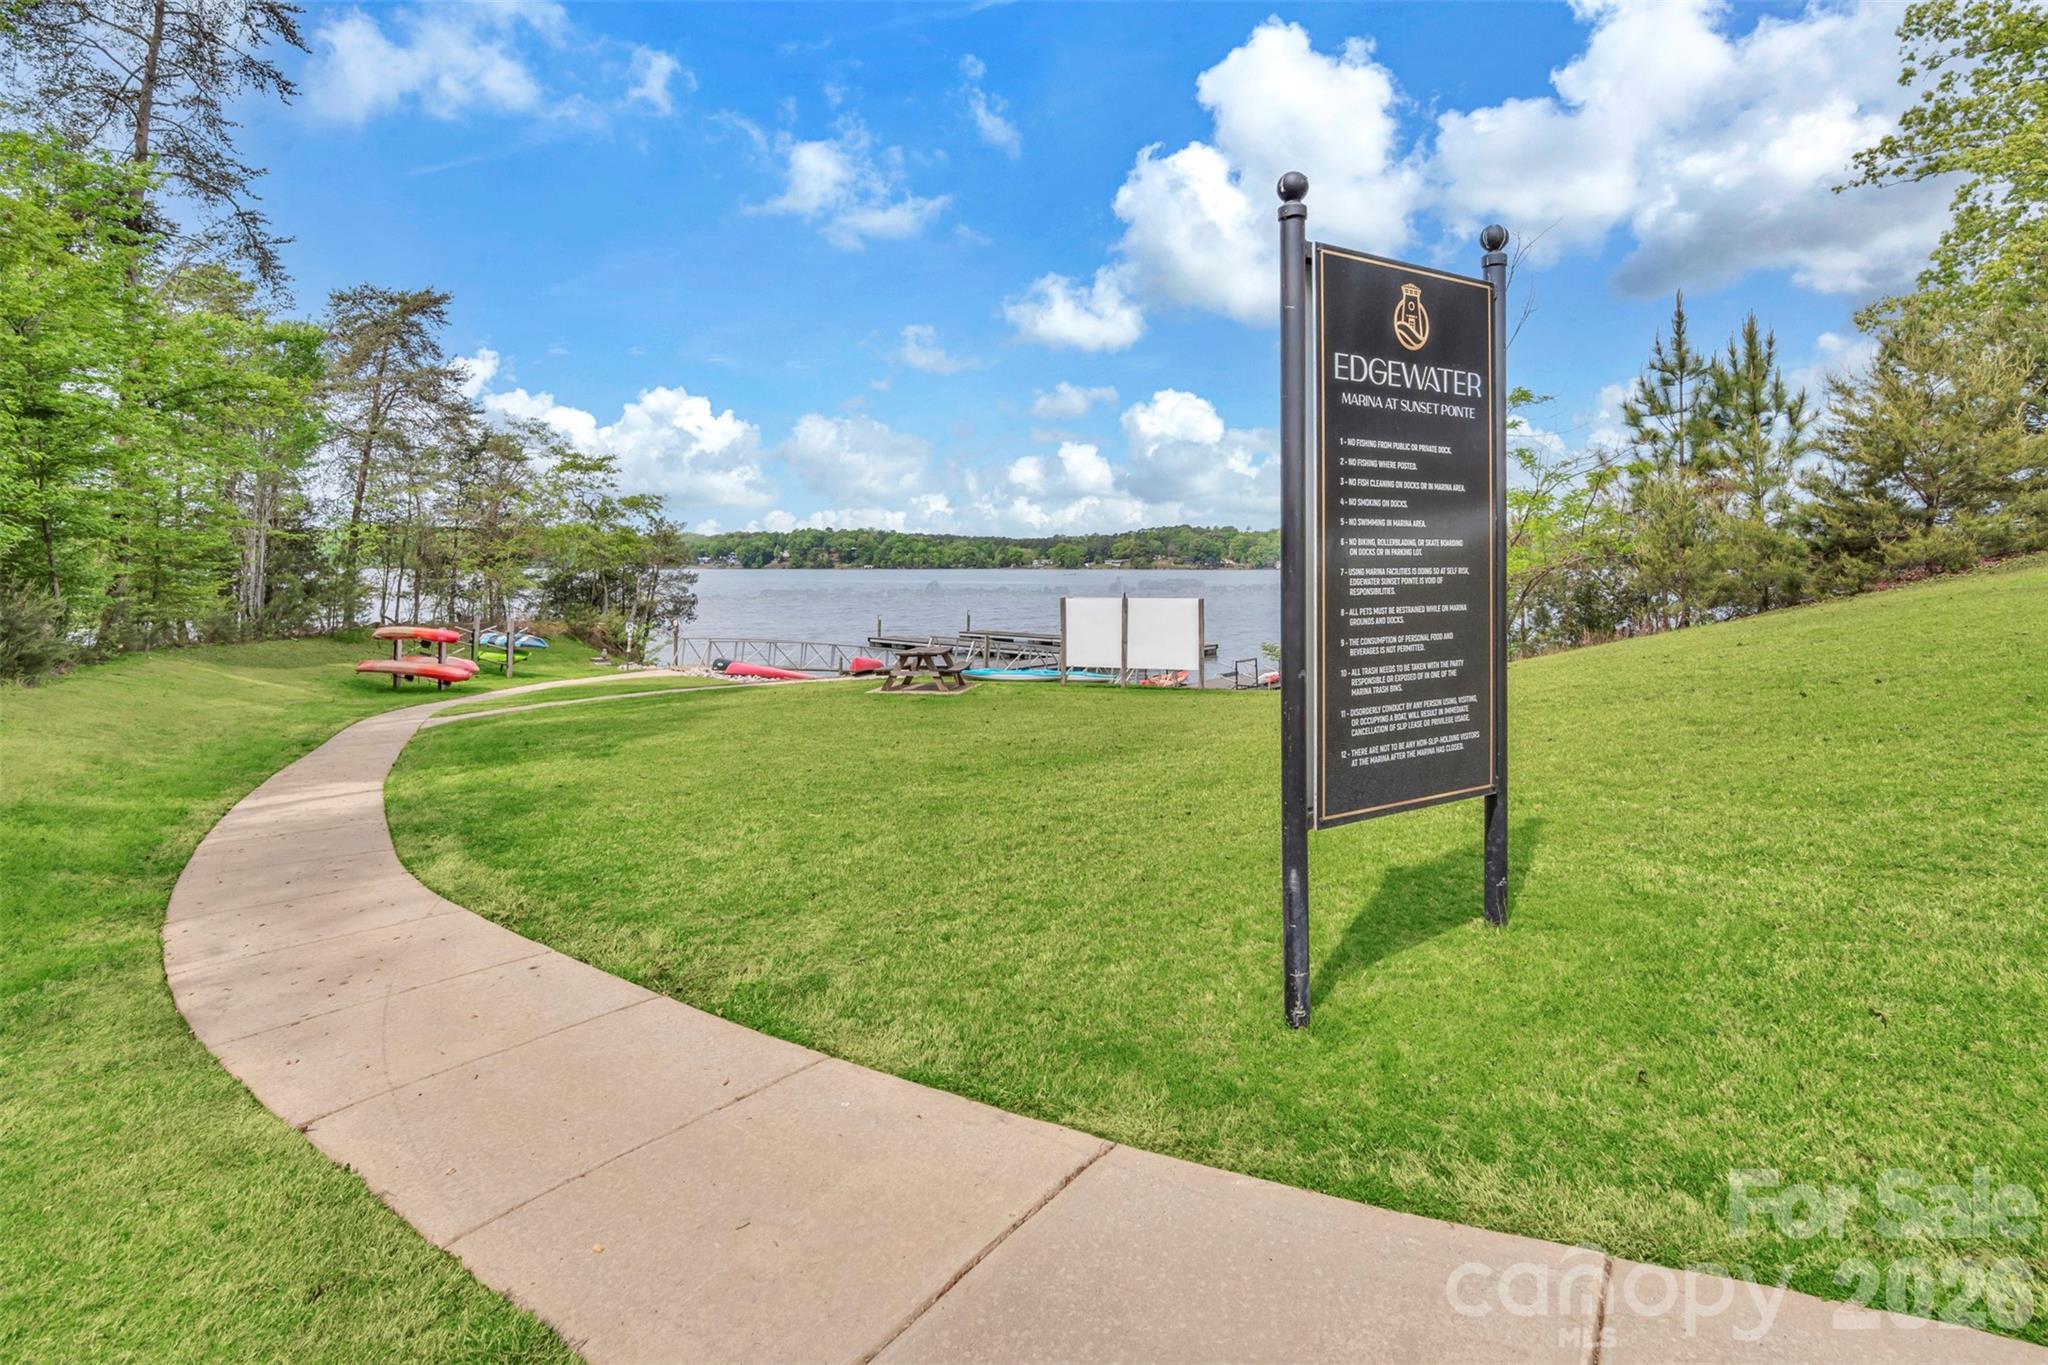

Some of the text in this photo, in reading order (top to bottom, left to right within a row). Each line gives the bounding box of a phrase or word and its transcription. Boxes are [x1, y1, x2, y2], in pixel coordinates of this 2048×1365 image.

[1334, 352, 1482, 398] EDGEWATER
[1342, 392, 1476, 419] MARINA AT SUNSET POINTE
[1340, 437, 1343, 445] 1
[1347, 437, 1355, 446] NO
[1356, 438, 1376, 448] FISHING
[1378, 440, 1392, 449] FROM
[1393, 442, 1410, 450] PUBLIC
[1411, 443, 1418, 451] OR
[1419, 444, 1437, 453] PRIVATE
[1340, 457, 1344, 465] 2
[1348, 457, 1356, 466] NO
[1357, 458, 1377, 467] FISHING
[1378, 460, 1396, 469] WHERE
[1340, 477, 1344, 485] 3
[1348, 477, 1356, 486] NO
[1358, 478, 1369, 486] FISH
[1370, 479, 1394, 488] CLEANING
[1396, 480, 1403, 488] ON
[1404, 481, 1419, 489] DOCKS
[1434, 483, 1452, 491] MARINA
[1349, 498, 1356, 506] NO
[1358, 498, 1381, 506] SMOKING
[1358, 518, 1385, 526] SWIMMING
[1360, 607, 1372, 615] PETS
[1374, 606, 1387, 614] MUST
[1396, 605, 1425, 613] RESTRAINED
[1350, 617, 1374, 626] GROUNDS
[1350, 638, 1359, 646] THE
[1360, 635, 1397, 645] CONSUMPTION
[1405, 633, 1429, 642] PERSONAL
[1350, 647, 1379, 656] BEVERAGES
[1351, 668, 1361, 676] ALL
[1362, 666, 1378, 675] TRASH
[1379, 665, 1395, 673] NEEDS
[1428, 661, 1439, 669] WITH
[1450, 659, 1464, 667] PARTY
[1351, 676, 1385, 686] RESPONSIBLE
[1352, 687, 1372, 696] MARINA
[1373, 685, 1389, 694] TRASH
[1350, 705, 1381, 716] DISORDERLY
[1382, 702, 1405, 712] CONDUCT
[1414, 700, 1423, 708] ANY
[1424, 698, 1442, 707] PERSON
[1360, 715, 1388, 725] OCCUPYING
[1408, 711, 1420, 719] WILL
[1421, 708, 1437, 717] RESULT
[1351, 724, 1388, 737] CANCELLATION
[1390, 724, 1396, 732] OF
[1397, 722, 1408, 730] SLIP
[1409, 720, 1422, 729] LEASE
[1351, 747, 1367, 757] THERE
[1368, 745, 1379, 754] ARE
[1380, 743, 1390, 752] NOT
[1391, 742, 1397, 750] TO
[1399, 741, 1405, 749] BE
[1406, 740, 1415, 748] ANY
[1352, 745, 1445, 767] AT THE MARINA AFTER THE MARINA HAS
